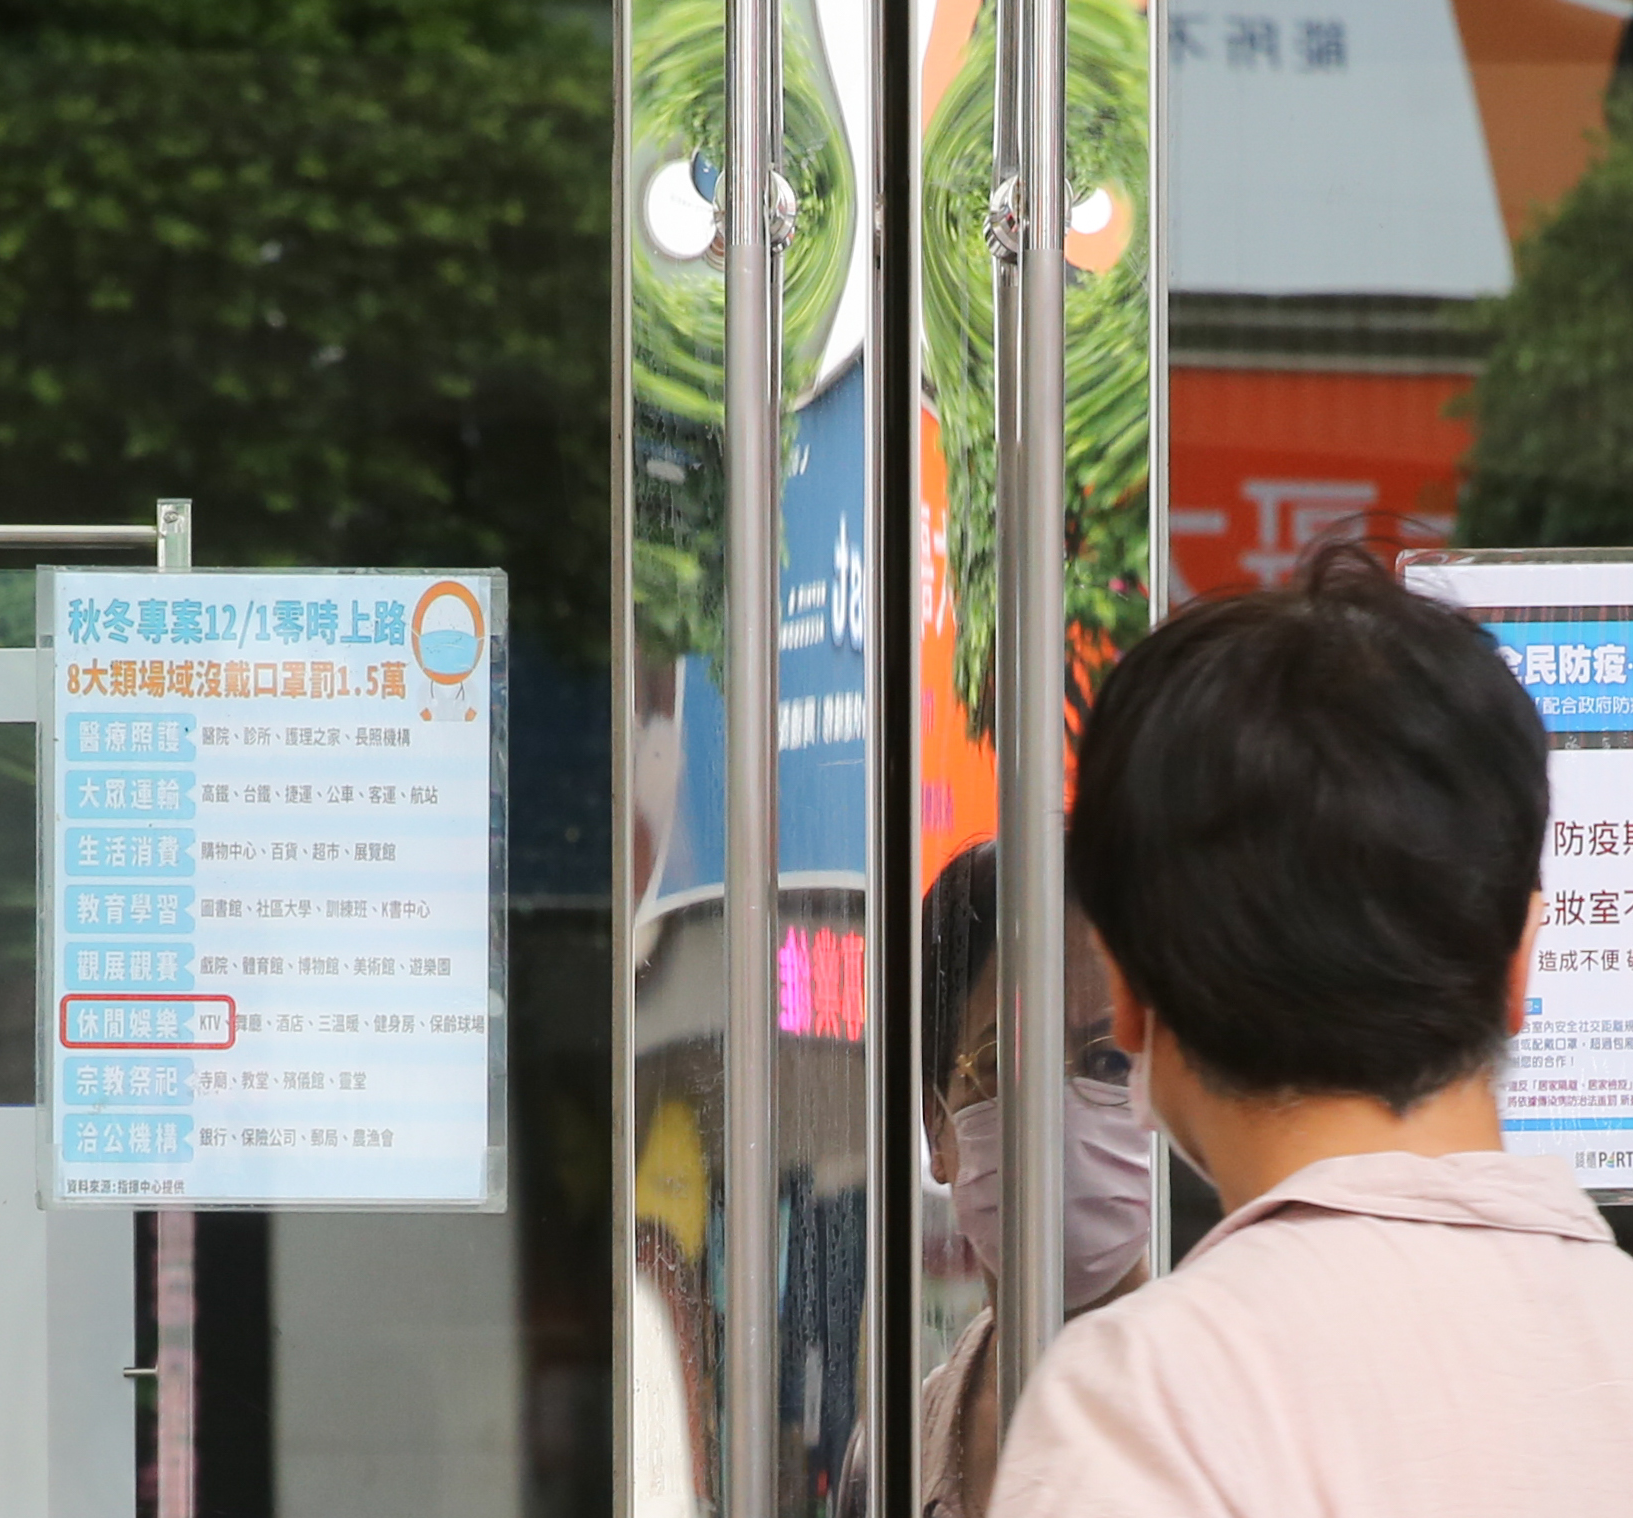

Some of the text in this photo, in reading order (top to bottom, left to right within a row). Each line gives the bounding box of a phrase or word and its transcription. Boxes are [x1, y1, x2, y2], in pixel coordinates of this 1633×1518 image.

[68, 599, 406, 648] 秋冬專案12/1零時上路
[67, 659, 407, 700] 8大類場域沒戴口罩罰1.5萬
[79, 720, 180, 754] 醫療照護
[201, 727, 411, 747] 醫院、診所、護理之家、長照機構
[78, 778, 180, 812] 大眾運輸
[201, 784, 439, 806] 高鐵、台鐵、捷運、公車、客運、航站
[77, 835, 179, 868] 生活消費
[200, 842, 396, 863] 購物中心、百貨、超市、展覽館
[77, 892, 179, 925] 教育學習
[200, 899, 431, 920] 圖書館、社區大學、訓練班、K書中心
[77, 950, 179, 982] 觀展觀賽
[200, 956, 451, 977] 戲院、體育館、博物館、美術館、遊樂園
[1538, 950, 1620, 973] 造成不便
[76, 1007, 179, 1039] 休閒娛樂
[76, 1065, 178, 1096] 宗教祭祀
[199, 1071, 367, 1091] 寺廟、教堂、殯儀館、靈堂
[76, 1122, 177, 1154] 洽公機構
[199, 1128, 394, 1149] 銀行、保險公司、郵局、農漁會
